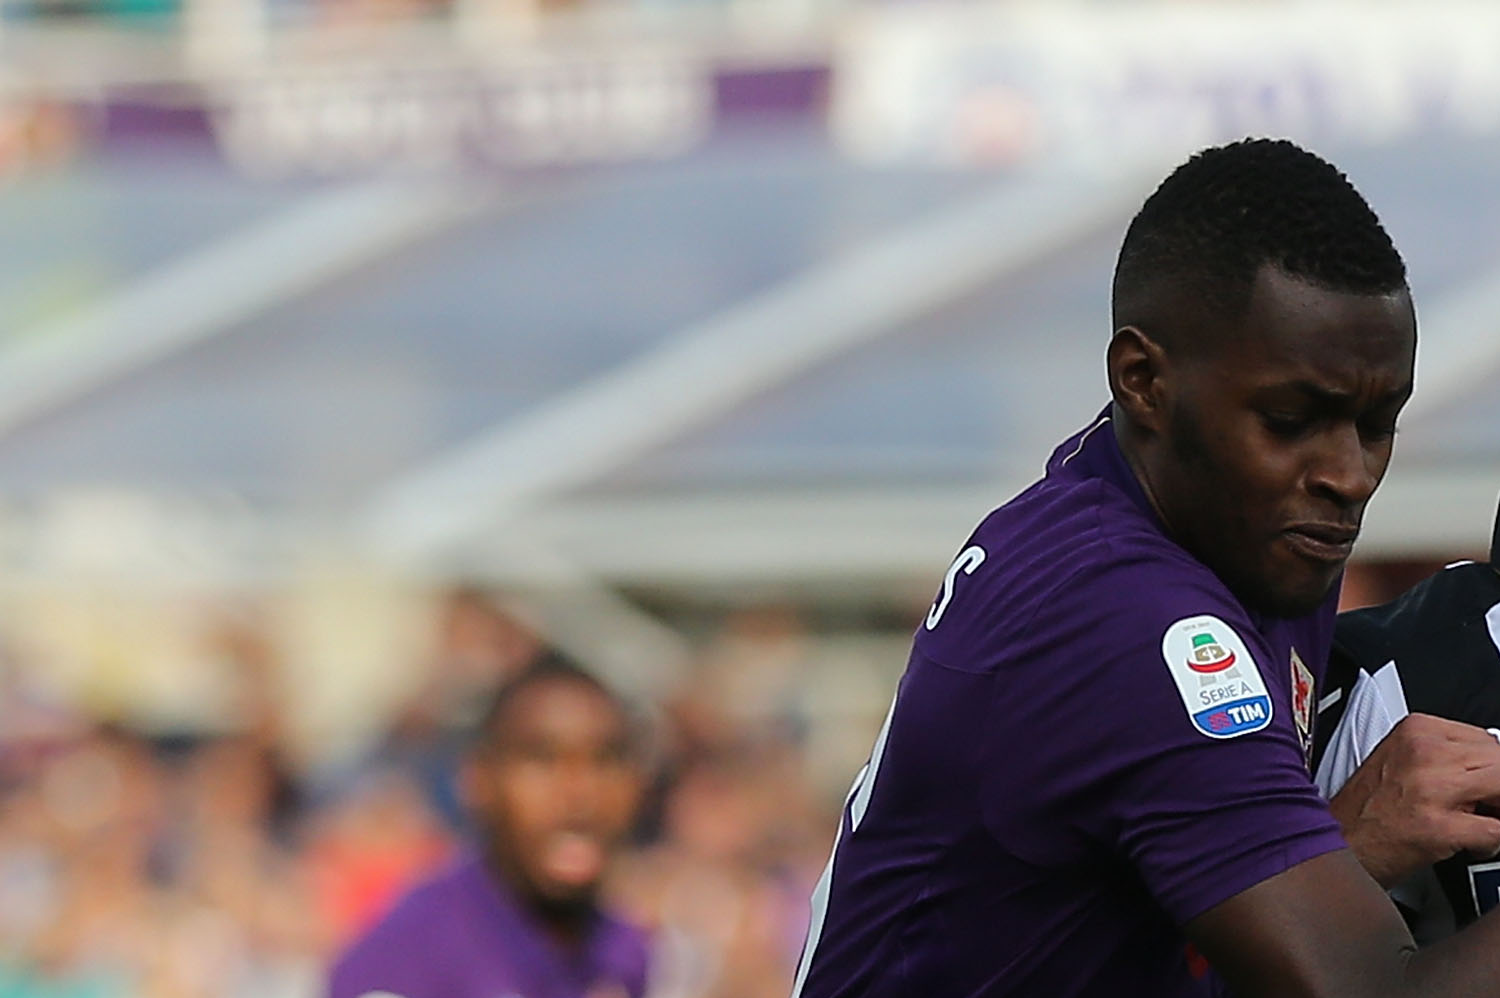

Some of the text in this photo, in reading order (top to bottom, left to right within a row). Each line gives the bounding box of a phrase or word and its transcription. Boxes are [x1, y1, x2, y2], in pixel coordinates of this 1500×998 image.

[1200, 681, 1254, 706] SERIE A
[1227, 702, 1265, 724] TIM
